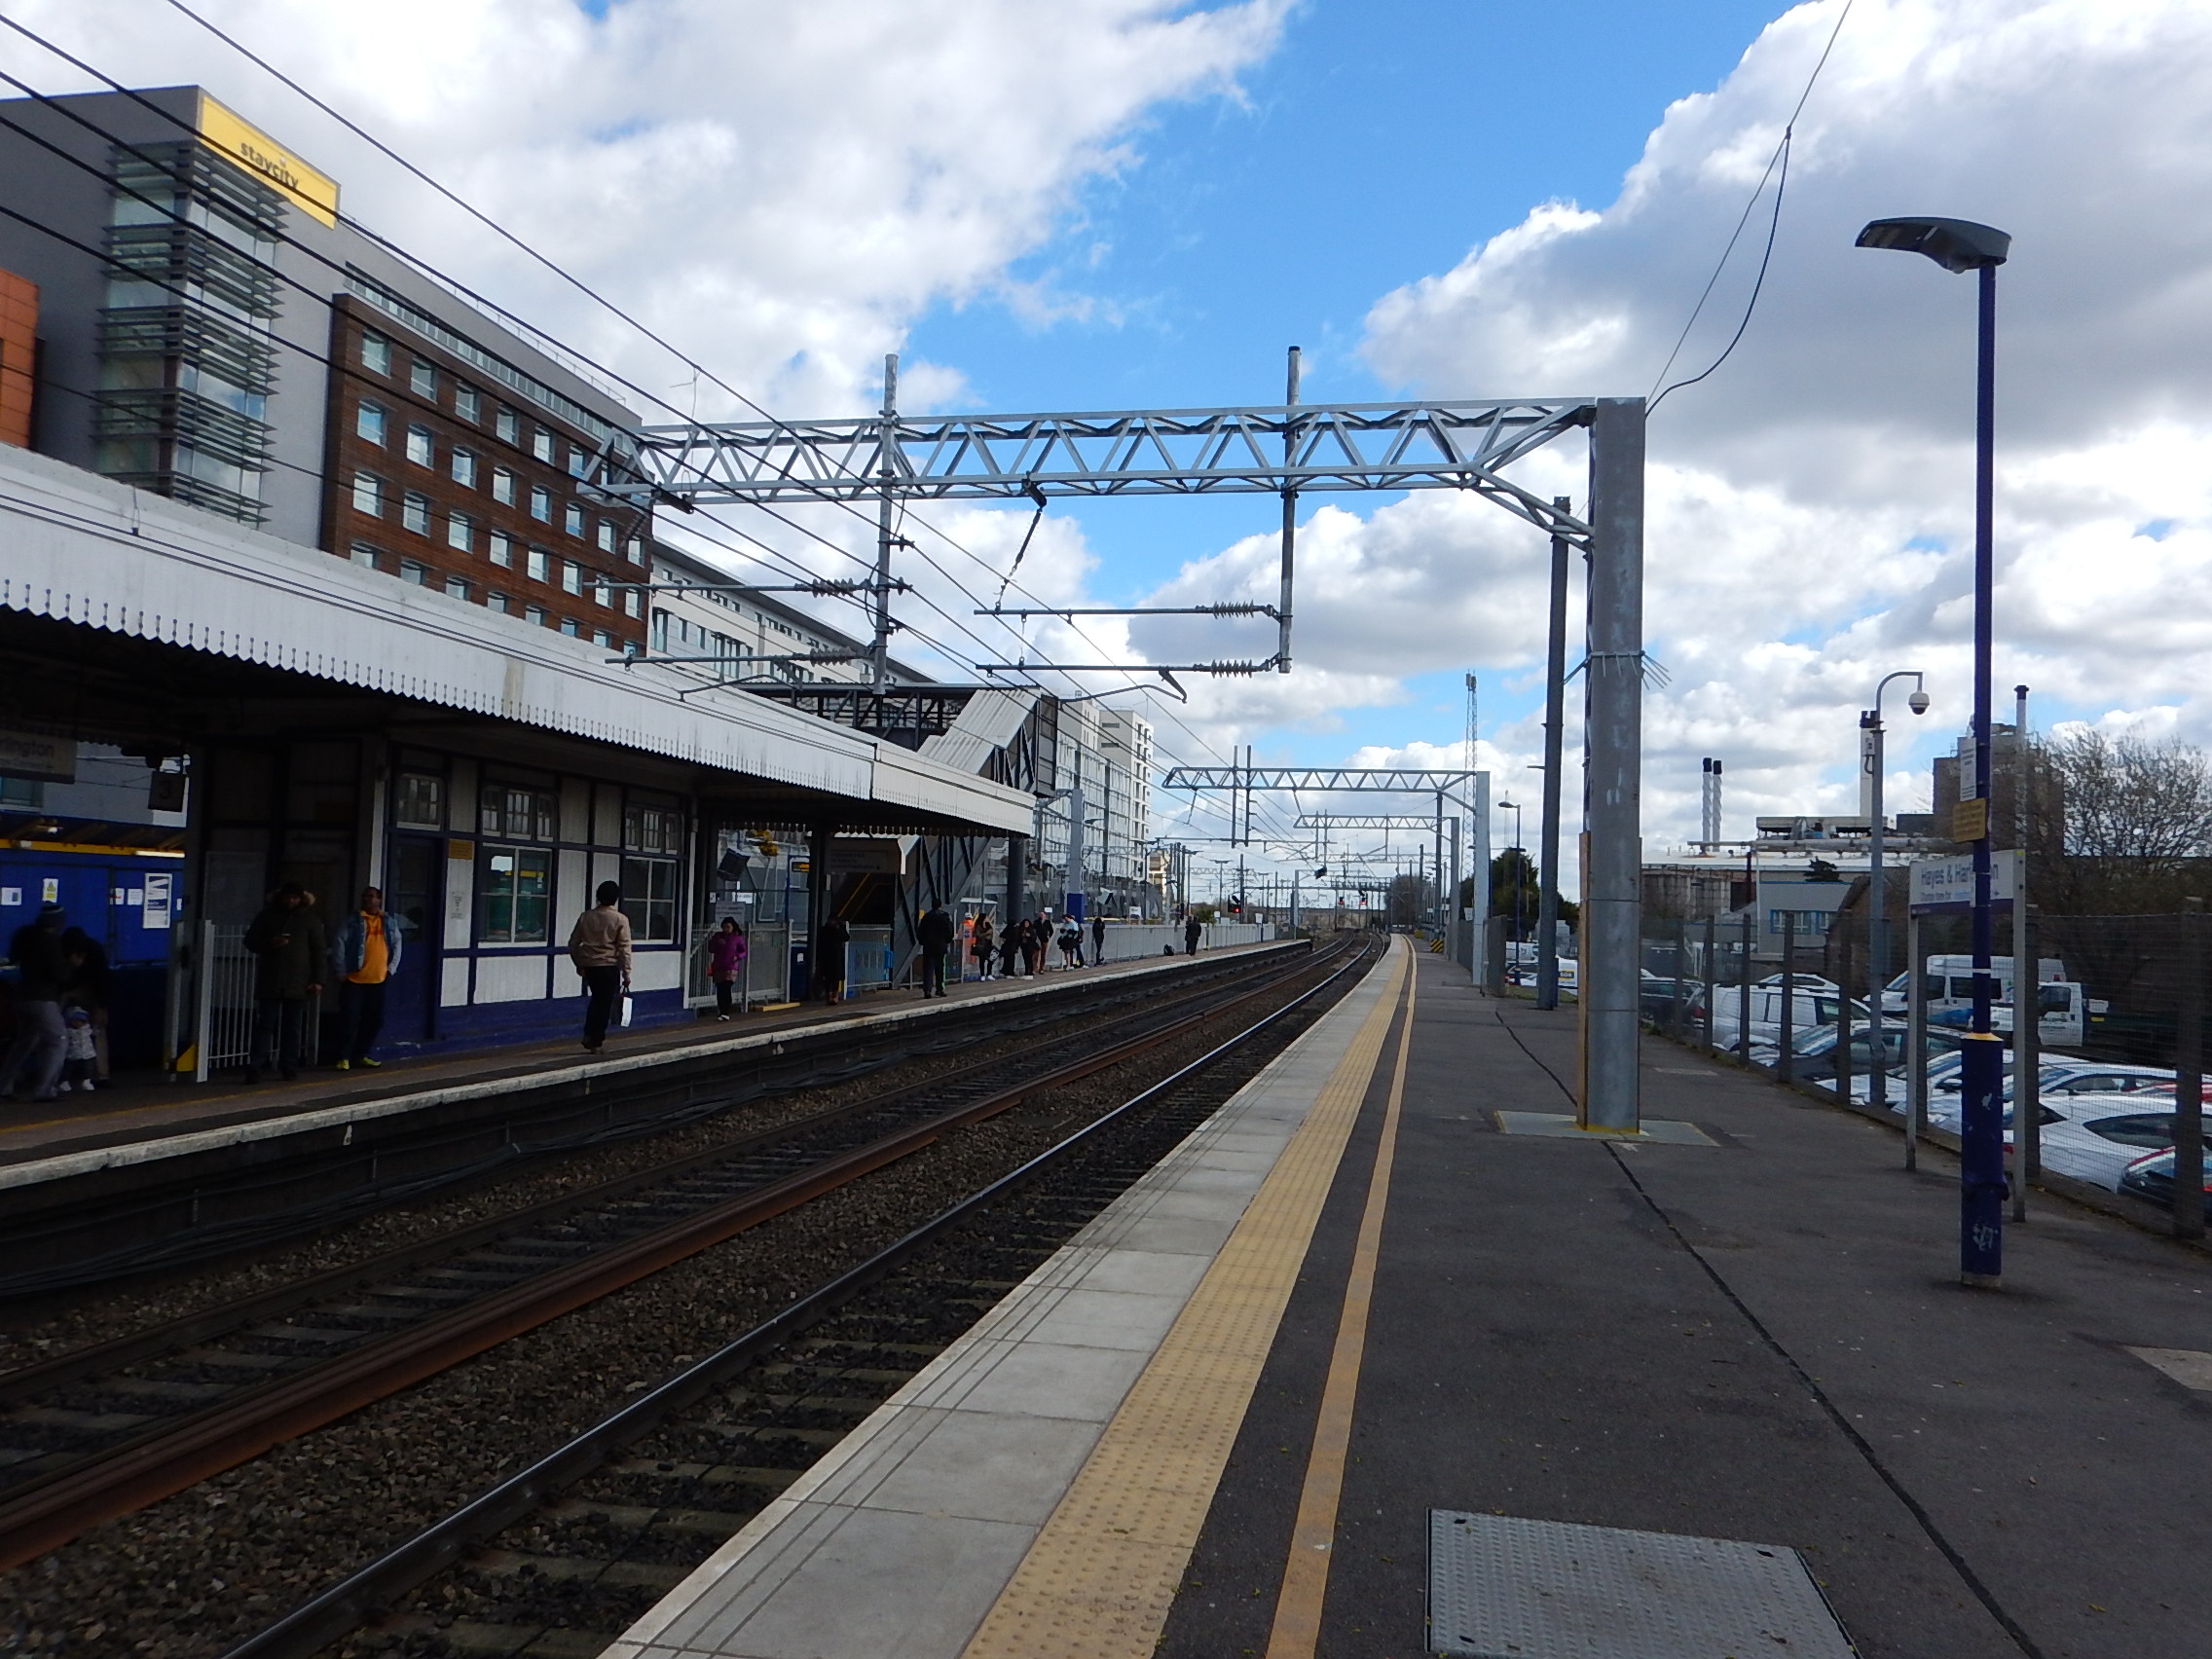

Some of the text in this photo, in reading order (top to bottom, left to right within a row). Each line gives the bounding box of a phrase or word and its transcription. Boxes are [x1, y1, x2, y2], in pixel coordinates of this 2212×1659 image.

[240, 141, 299, 189] staycity
[158, 780, 172, 800] 3
[1921, 867, 1944, 889] Hayes
